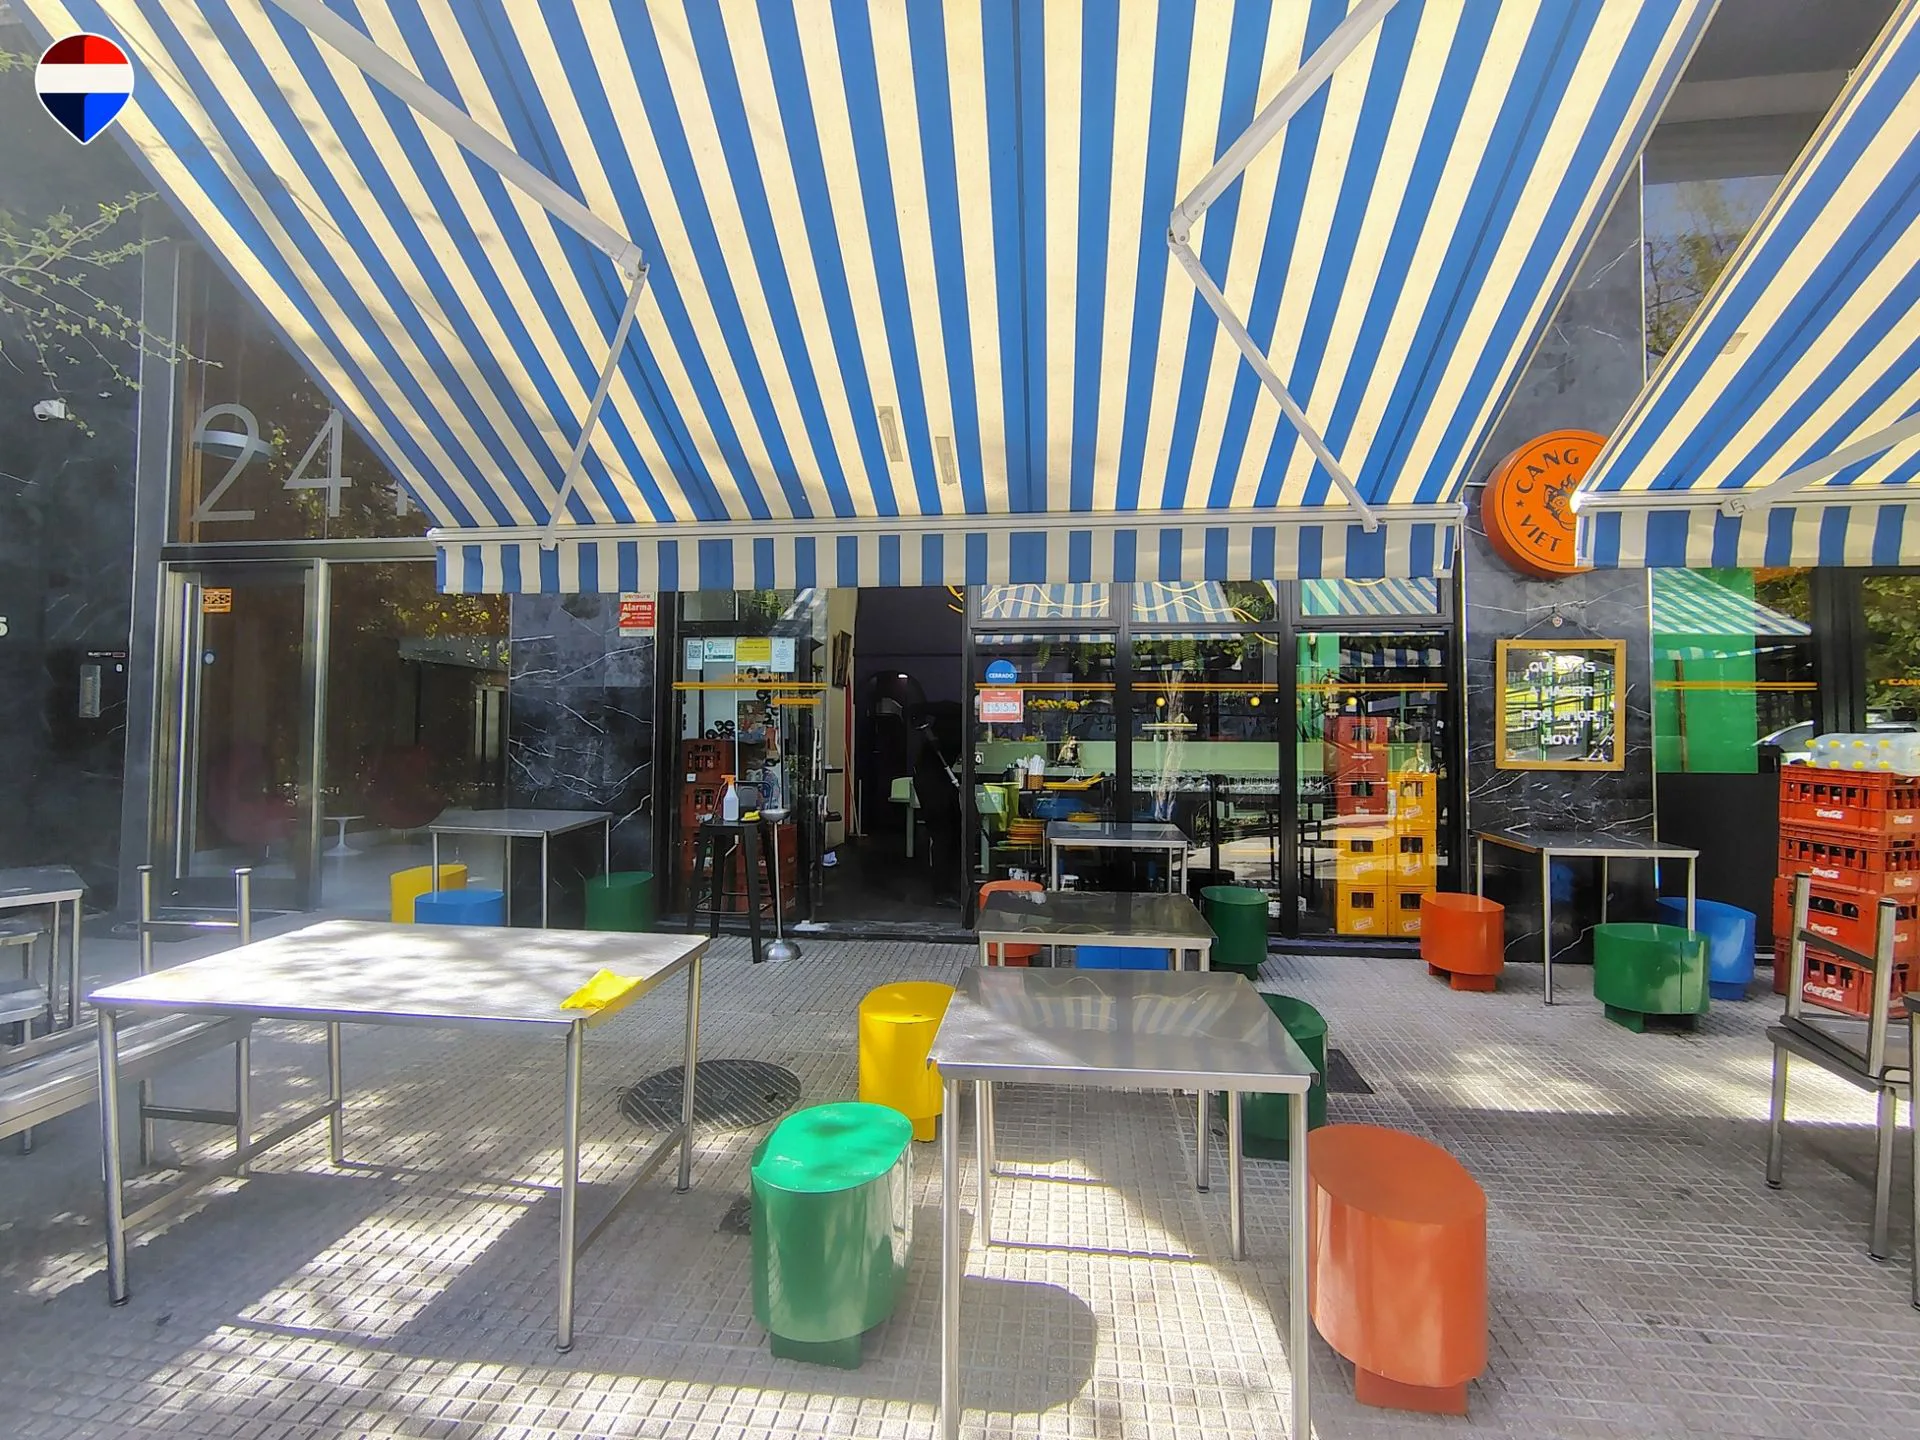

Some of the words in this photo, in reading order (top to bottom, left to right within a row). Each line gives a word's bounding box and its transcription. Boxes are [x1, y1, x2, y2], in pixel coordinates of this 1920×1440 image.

[1516, 448, 1579, 493] CANG
[622, 603, 652, 611] Alarma
[1541, 731, 1580, 745] HOY?
